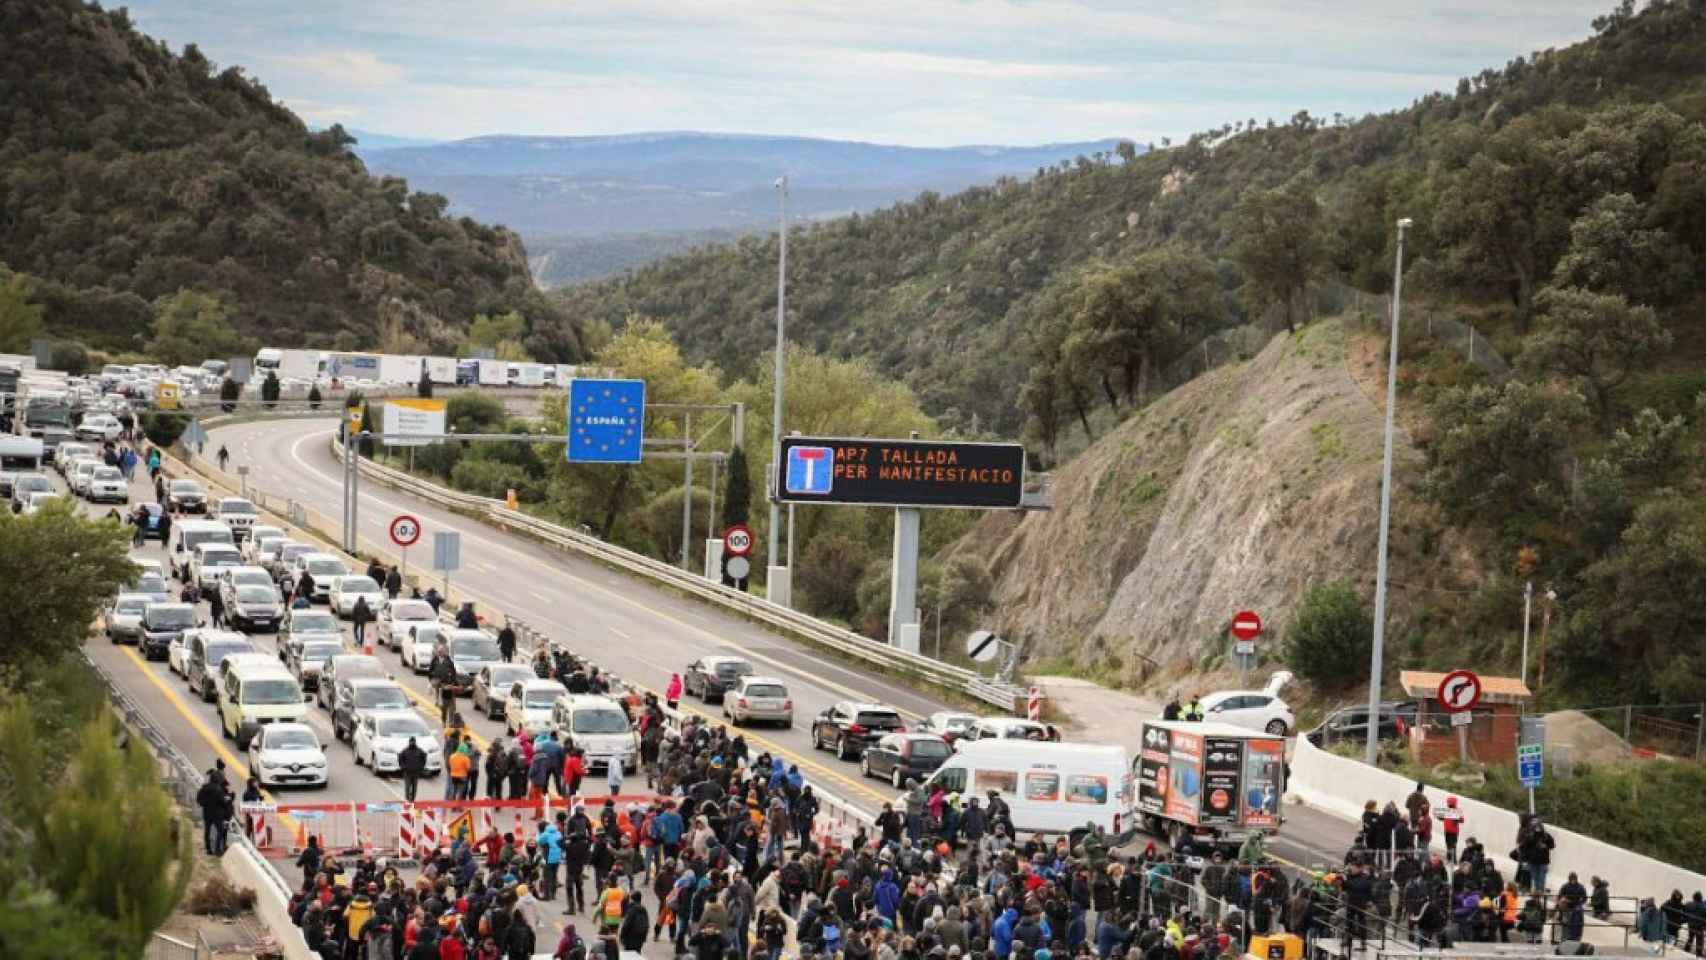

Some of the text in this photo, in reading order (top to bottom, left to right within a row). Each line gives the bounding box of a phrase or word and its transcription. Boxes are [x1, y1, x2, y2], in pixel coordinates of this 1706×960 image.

[586, 416, 625, 424] ESPAÑA
[836, 447, 957, 465] AP7 TALLADA
[834, 463, 1012, 483] PER MANIFESTACIO
[731, 535, 749, 547] 100
